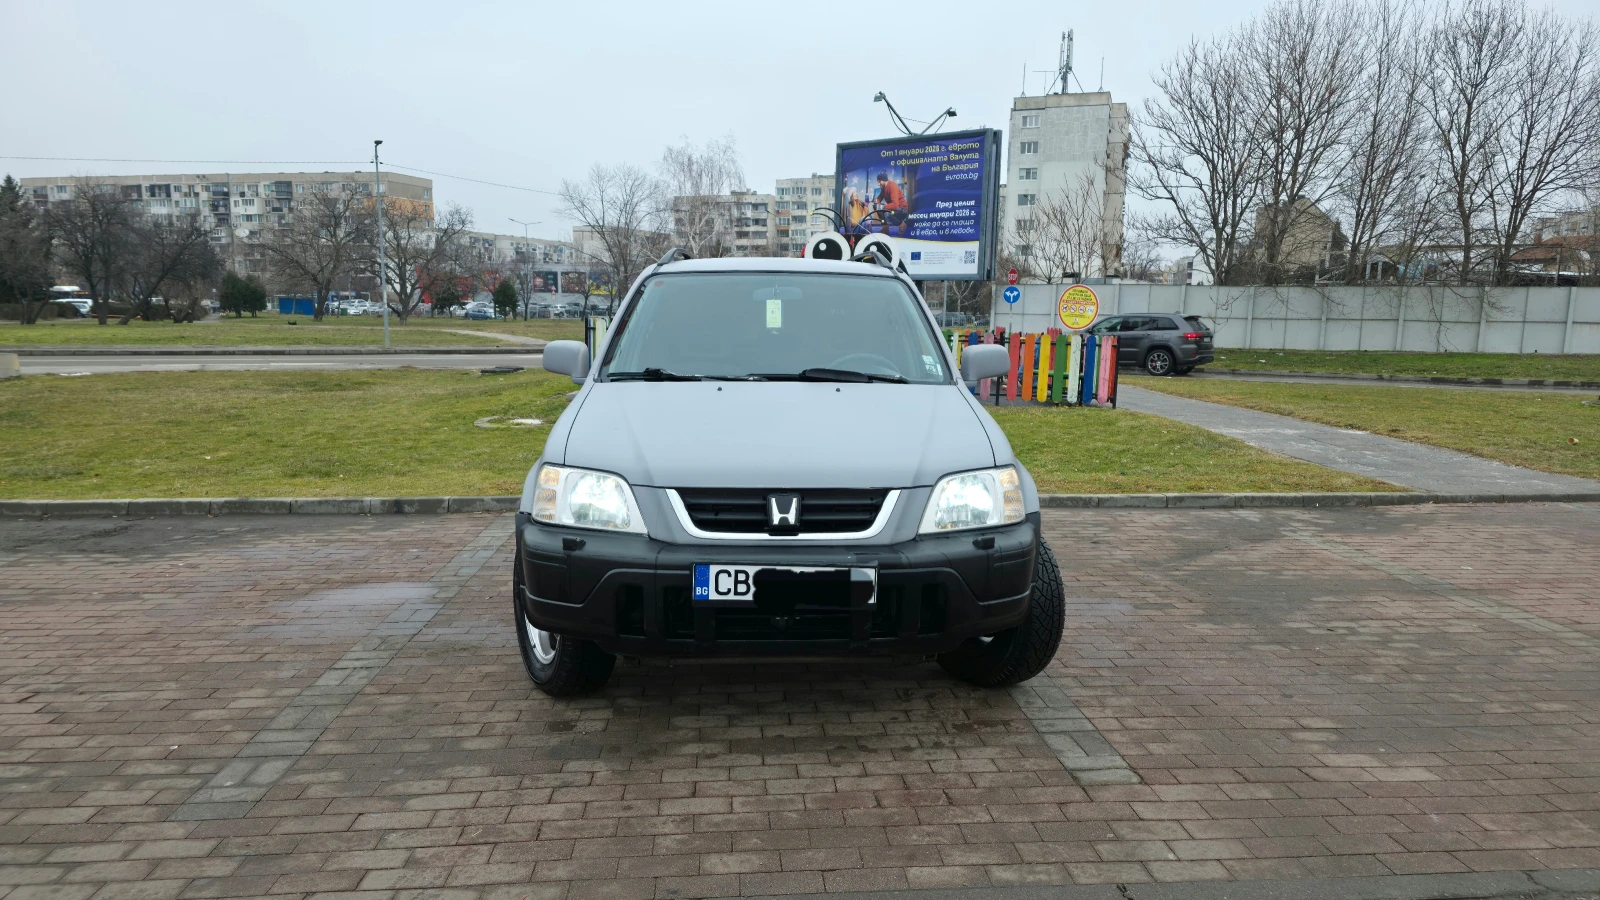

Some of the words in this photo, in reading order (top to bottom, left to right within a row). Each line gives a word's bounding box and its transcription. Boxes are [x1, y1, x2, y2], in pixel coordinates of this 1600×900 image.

[898, 148, 924, 157] януари
[948, 142, 980, 152] еврото
[896, 155, 948, 166] официалната
[949, 152, 979, 161] валута
[942, 162, 979, 172] България
[945, 172, 979, 181] evroto.bg
[936, 201, 952, 209] През
[929, 211, 954, 219] януари
[955, 209, 970, 217] 2026
[714, 569, 751, 596] CB
[696, 586, 708, 595] BG
